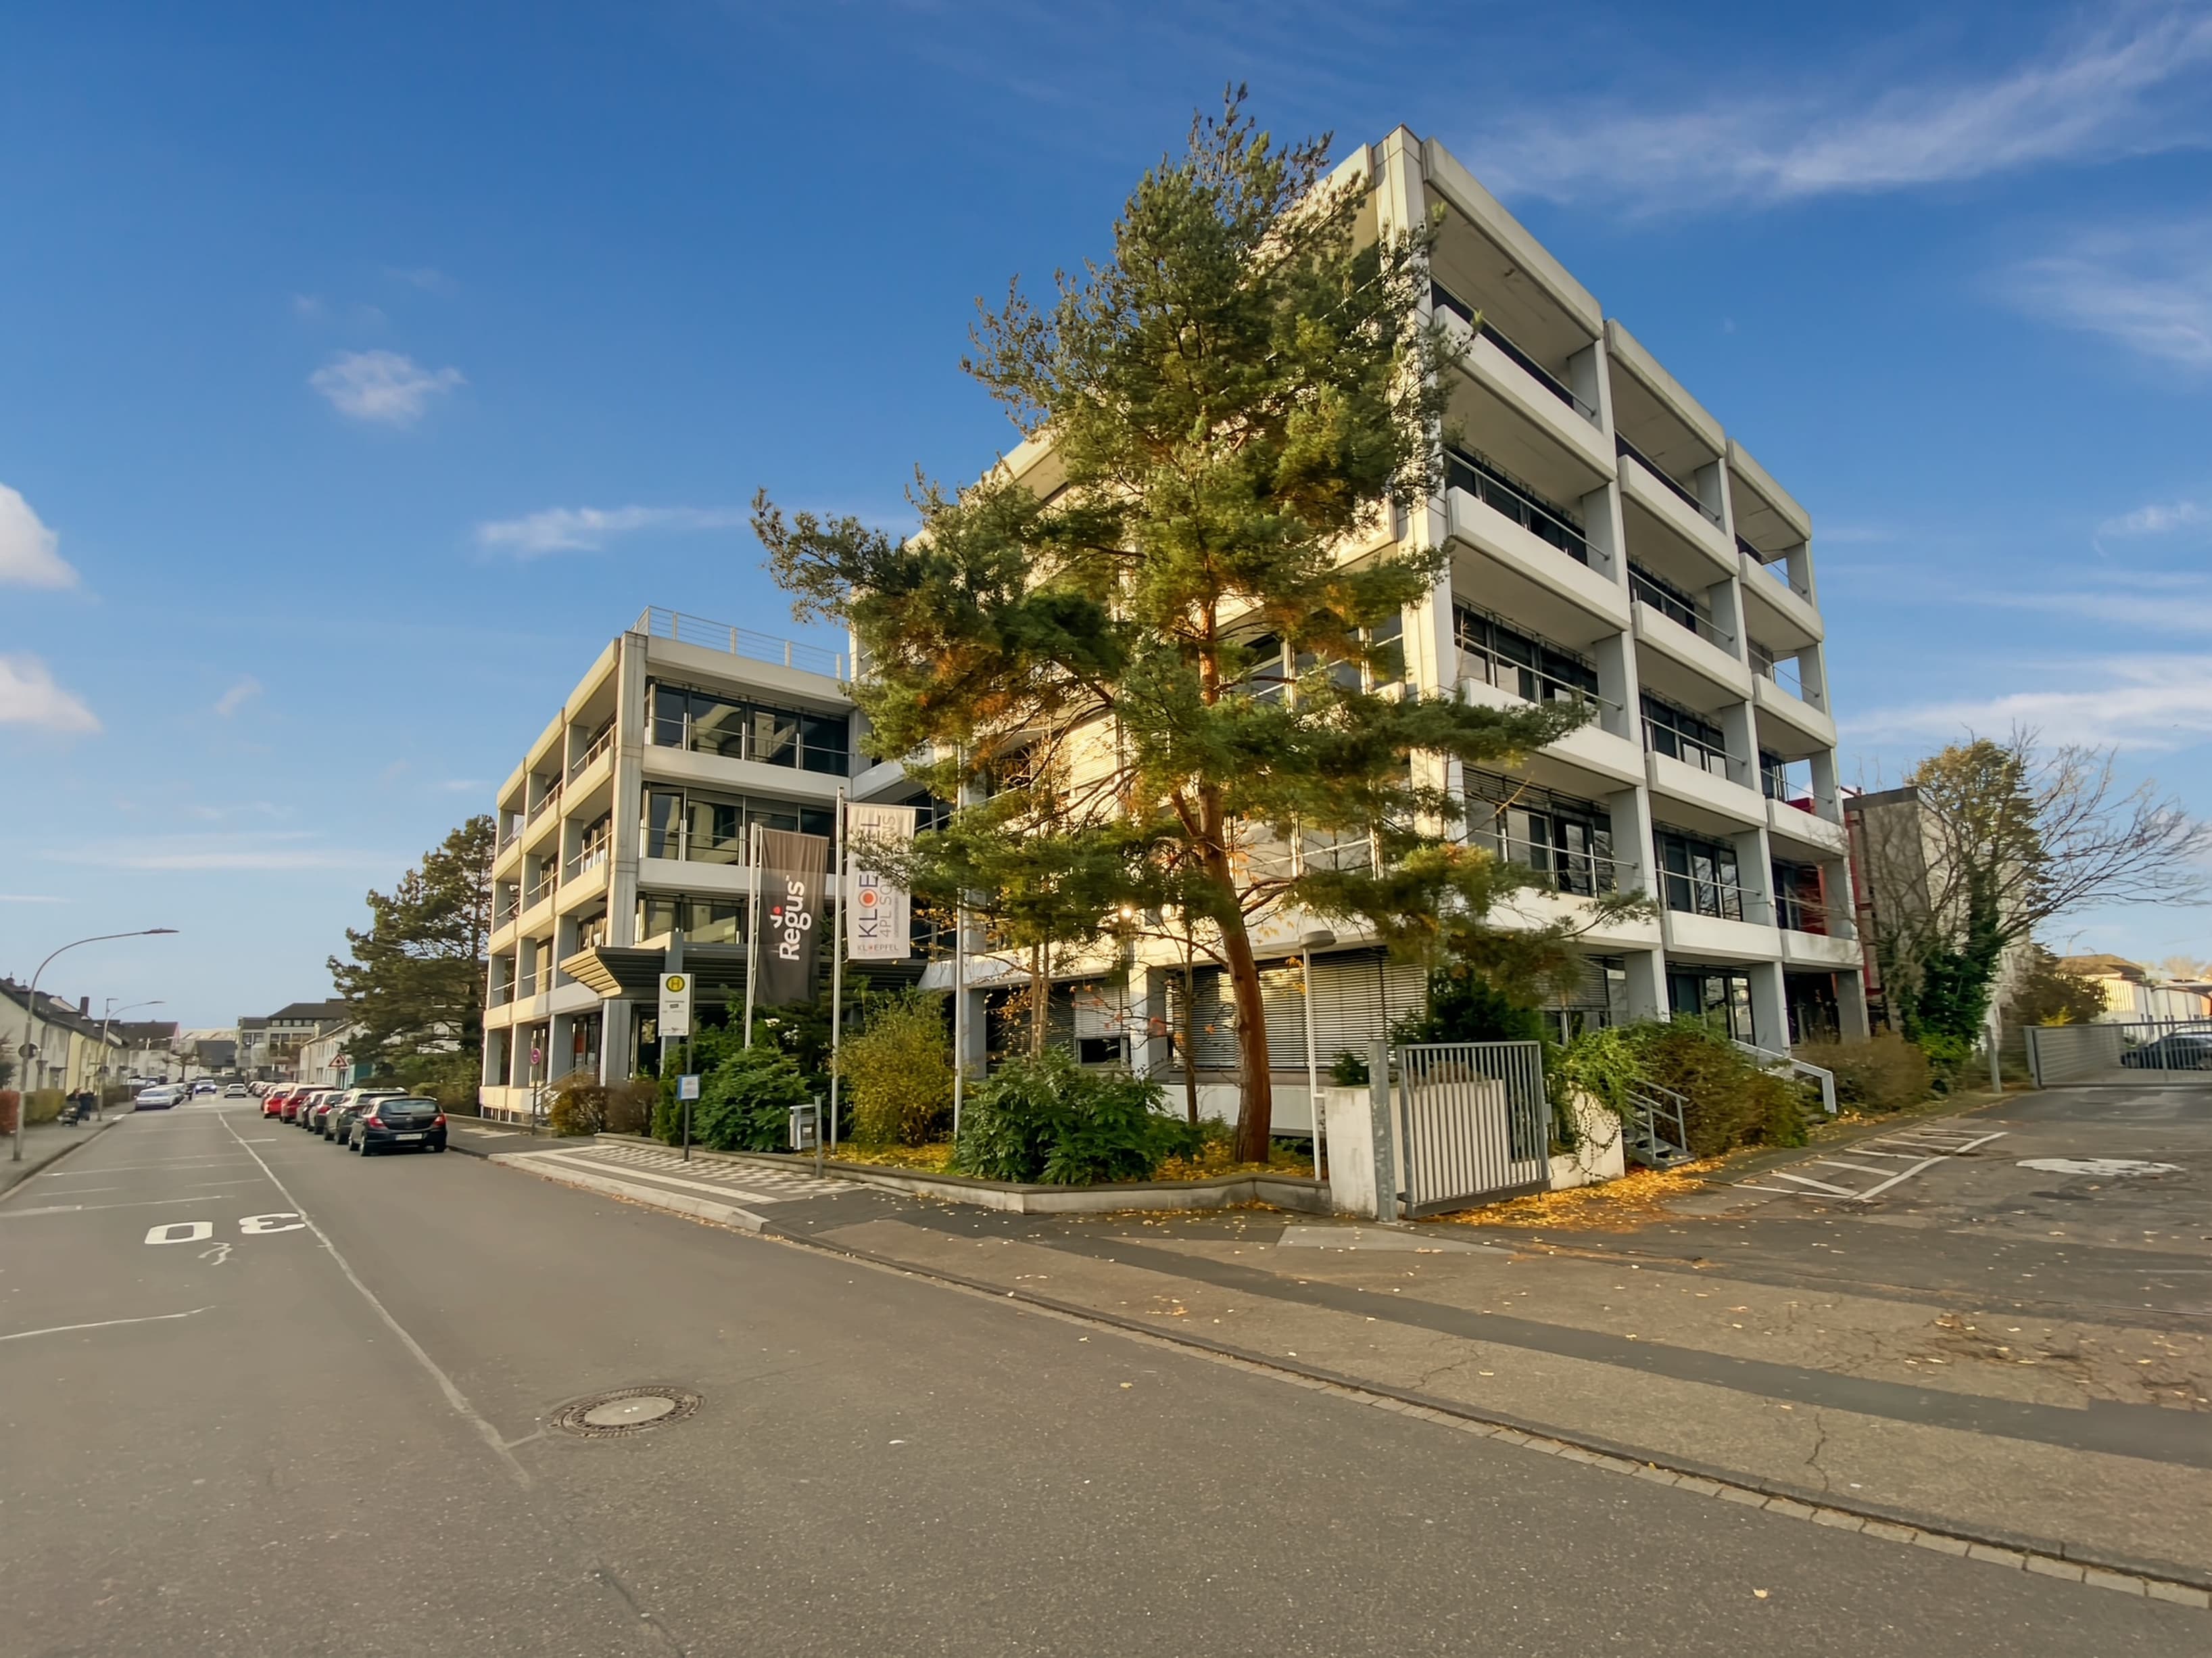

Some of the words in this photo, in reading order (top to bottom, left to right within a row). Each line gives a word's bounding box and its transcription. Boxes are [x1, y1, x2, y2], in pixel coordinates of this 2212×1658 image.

[859, 815, 881, 938] KLOEEL
[779, 881, 811, 960] Regus
[880, 911, 892, 938] 4PL
[671, 978, 680, 989] H
[144, 1212, 306, 1244] 30
